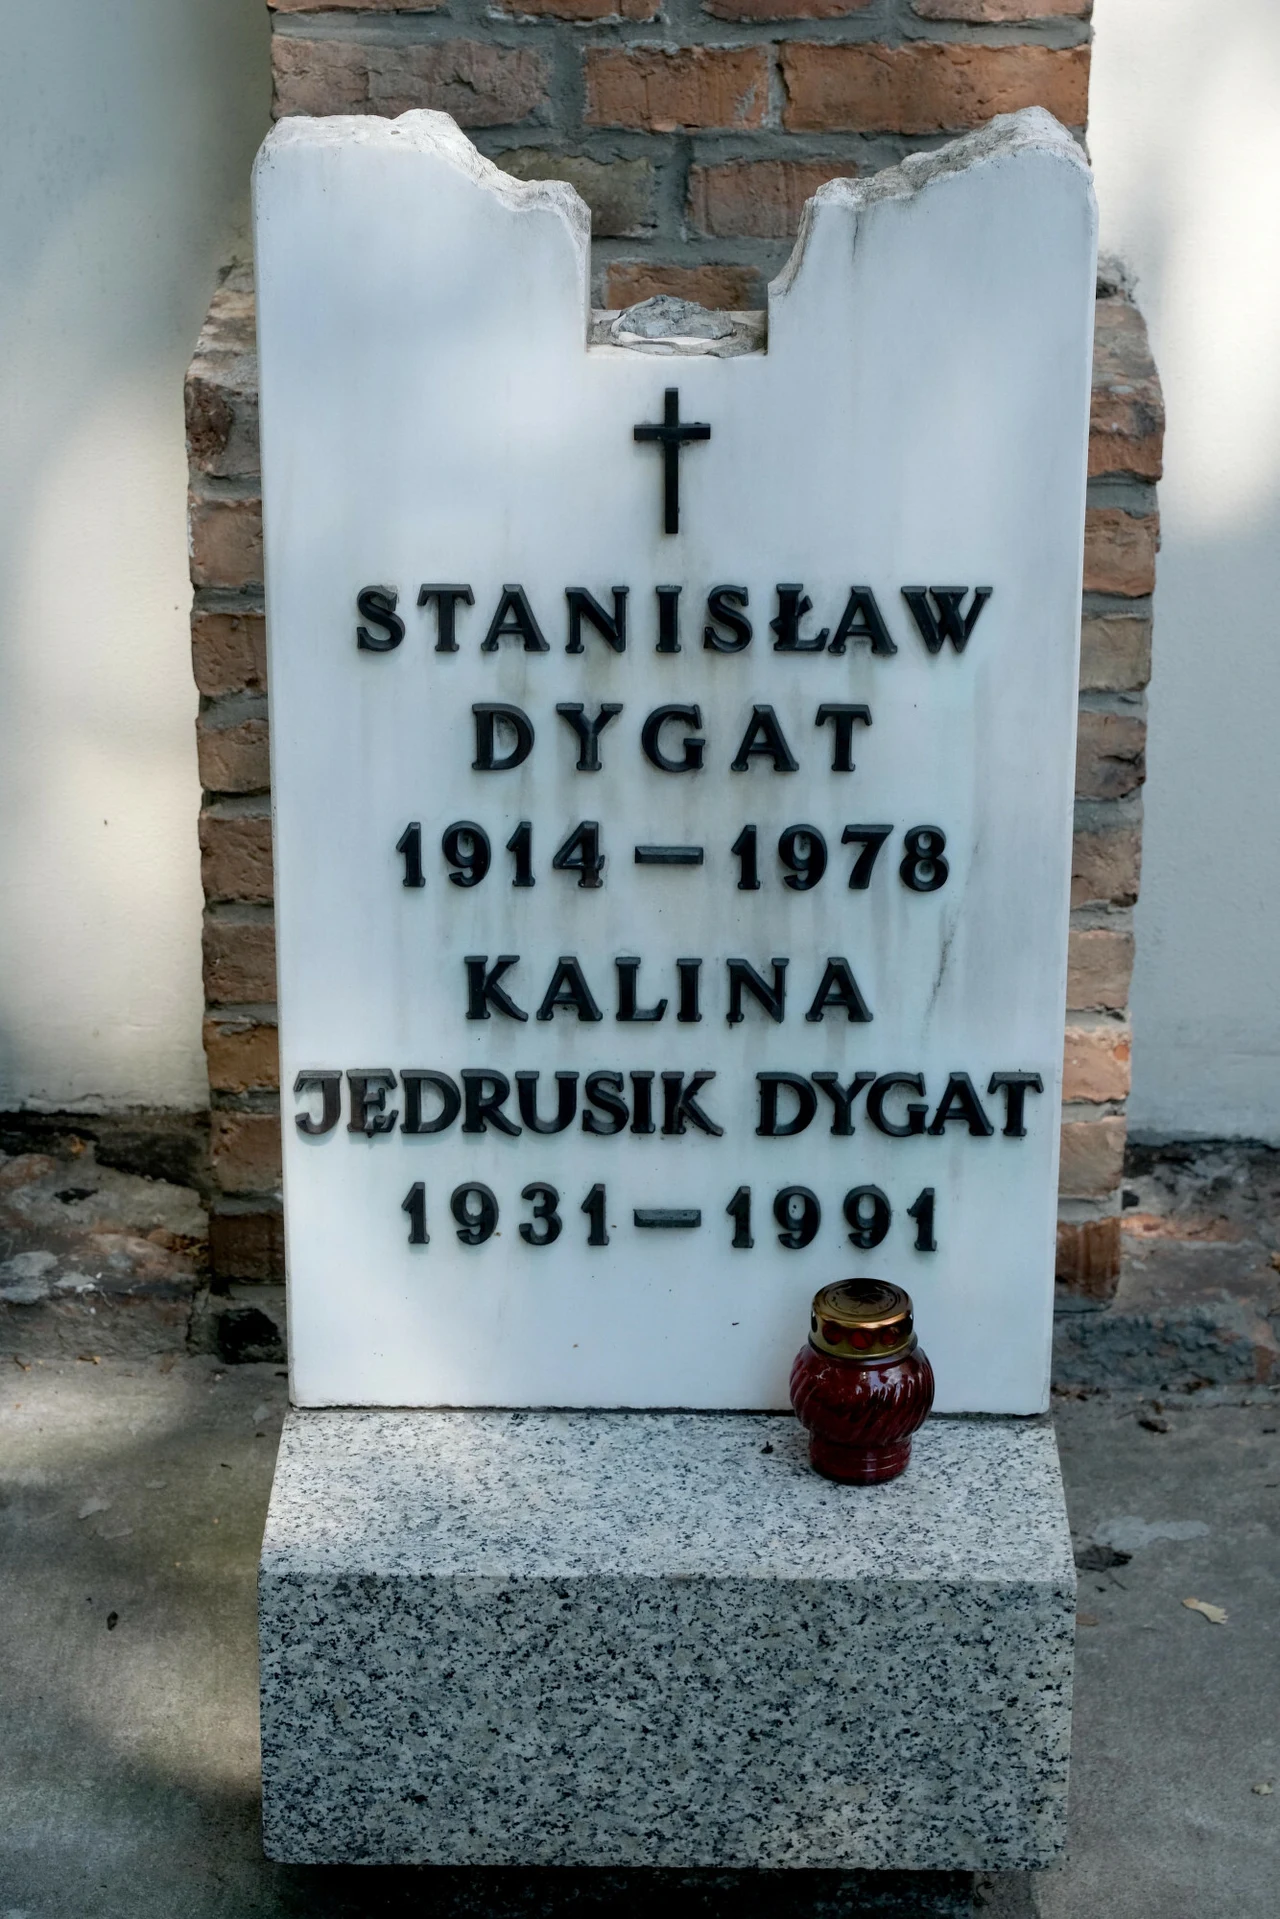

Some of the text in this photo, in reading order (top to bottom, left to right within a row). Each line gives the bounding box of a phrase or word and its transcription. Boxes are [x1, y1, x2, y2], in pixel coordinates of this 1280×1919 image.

[356, 584, 993, 655] STANISŁAW
[471, 703, 873, 773] DYGAT
[464, 955, 874, 1023] KALINA
[755, 1070, 1044, 1138] DYGAT
